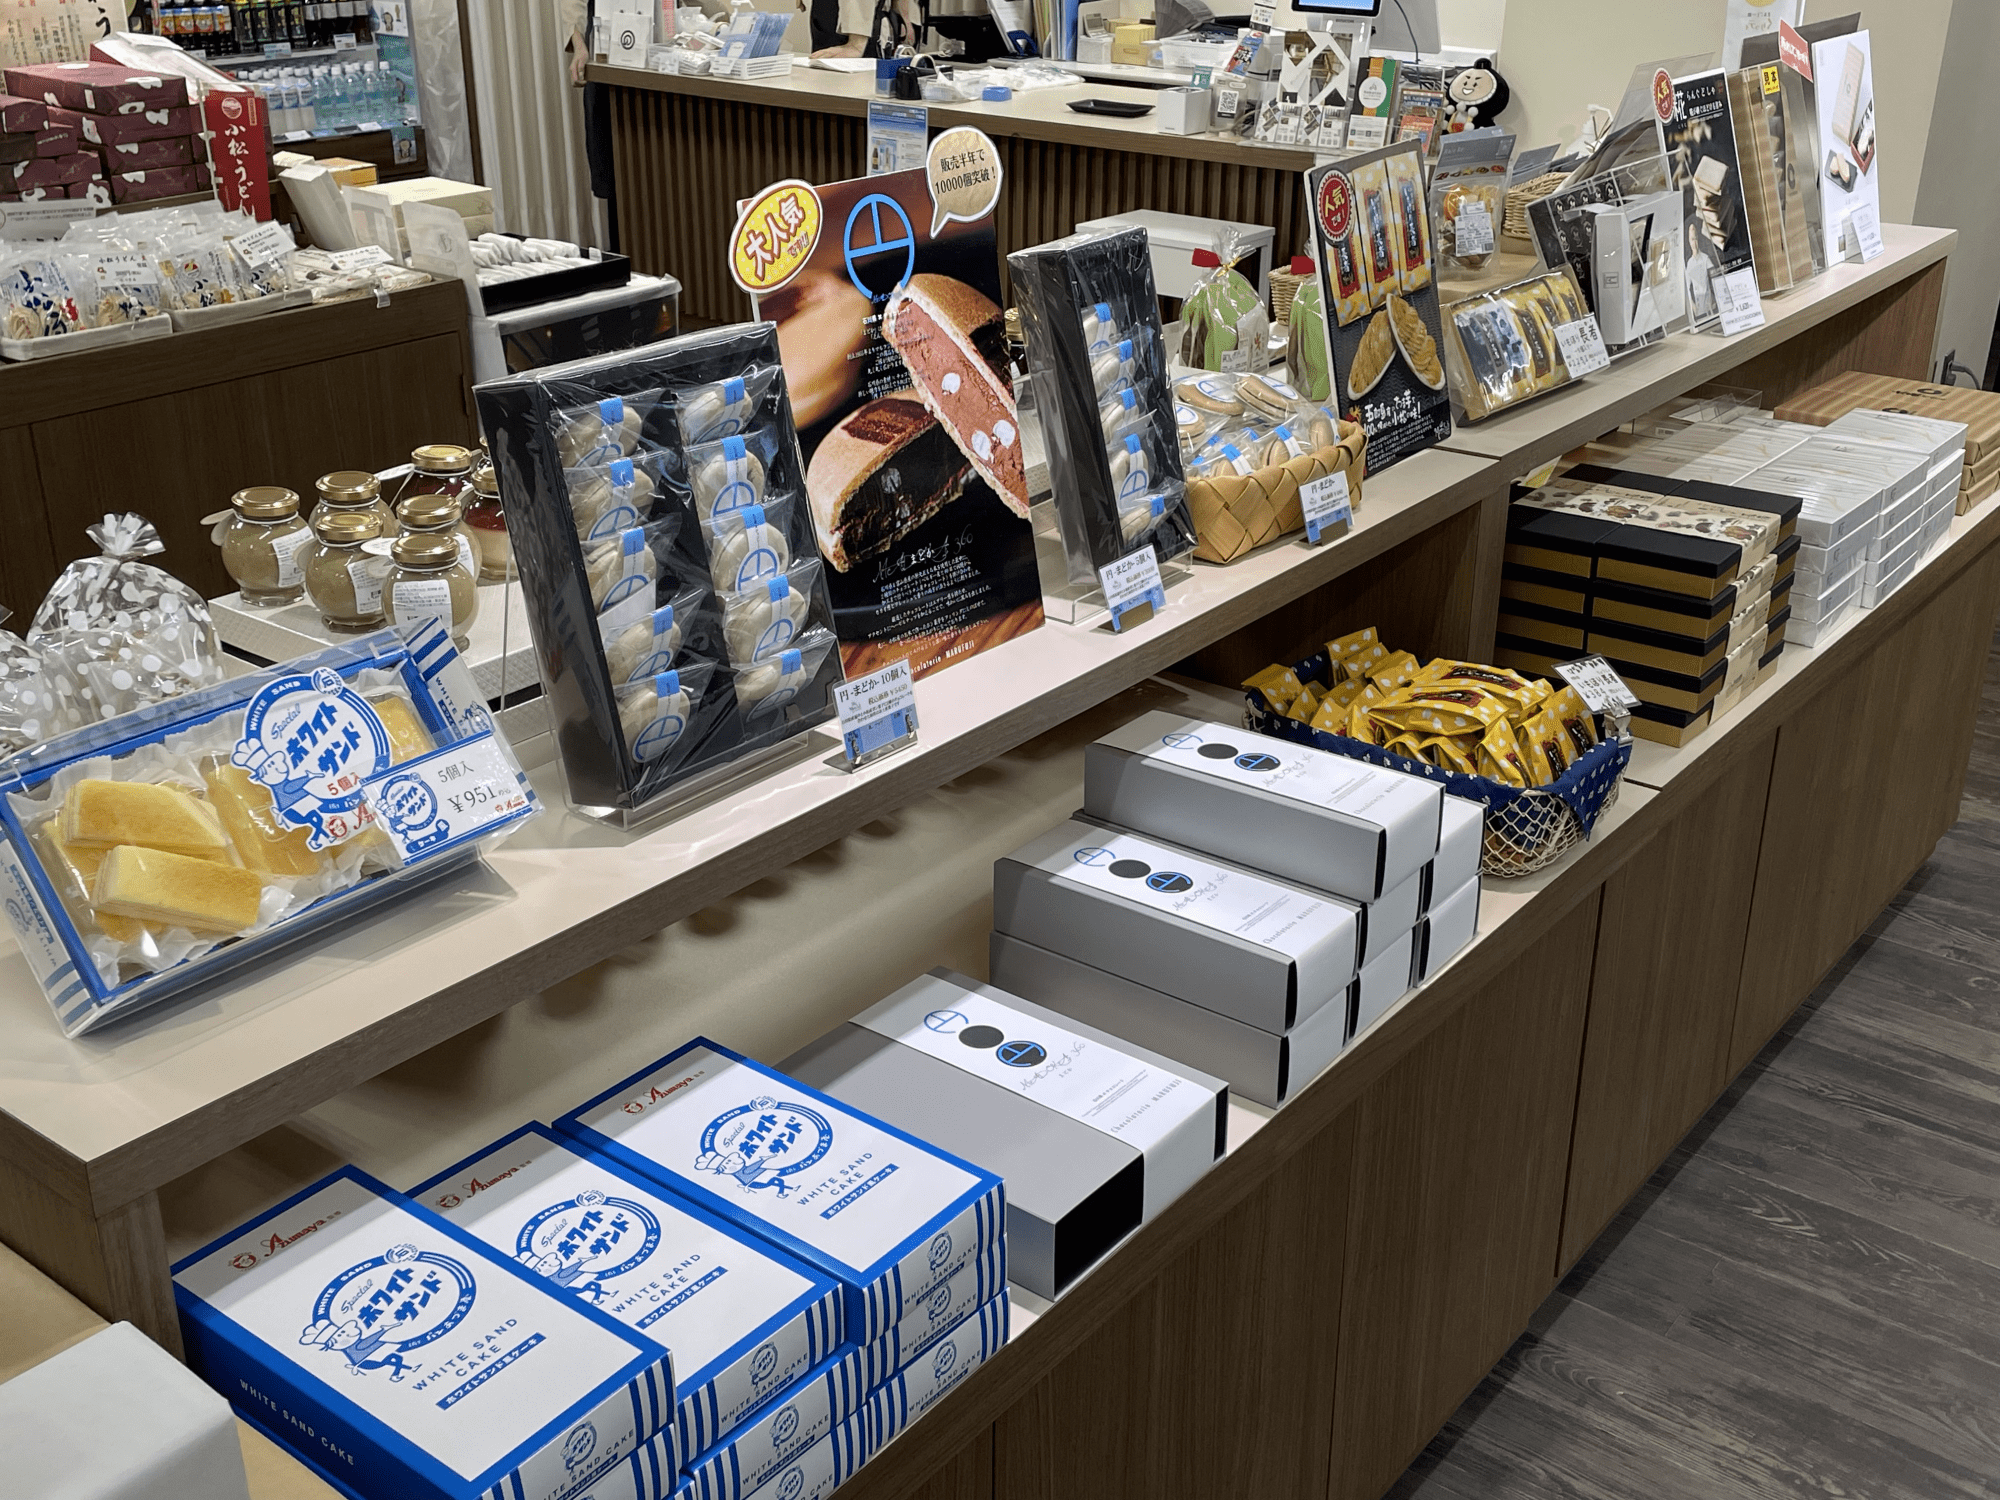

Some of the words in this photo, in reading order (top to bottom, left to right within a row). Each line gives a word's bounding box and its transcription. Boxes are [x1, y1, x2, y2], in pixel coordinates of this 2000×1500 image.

[1763, 71, 1777, 86] 見本
[940, 148, 985, 173] 販売半年で
[1325, 185, 1345, 218] 人気
[744, 192, 806, 282] 大人気
[946, 640, 975, 659] MARUFUJI
[250, 699, 268, 731] WHITE
[271, 681, 301, 696] SAND
[271, 702, 301, 740] Special
[286, 701, 338, 770] ホワイト
[317, 721, 361, 777] サンド
[438, 761, 474, 783] 5個入
[447, 785, 498, 813] ¥951
[647, 1076, 694, 1105] Azumaya
[704, 1127, 717, 1149] WHITE
[716, 1109, 742, 1125] SAND
[738, 1113, 779, 1160] ホワイト
[767, 1115, 803, 1155] サンド
[1110, 1103, 1151, 1133] Chocolaterie
[462, 1166, 519, 1199] Azumaya
[797, 1175, 839, 1207] WHITE
[841, 1152, 874, 1176] SAND
[830, 1170, 865, 1197] CAKE
[261, 1219, 326, 1258] Azumaya
[520, 1224, 535, 1249] WHITE
[538, 1204, 565, 1221] SAND
[541, 1218, 568, 1248] Special
[556, 1210, 604, 1261] ホワイト
[588, 1212, 630, 1258] サンド
[317, 1287, 337, 1316] WHITE
[340, 1262, 373, 1282] SAND
[611, 1282, 660, 1314] WHITE
[663, 1254, 702, 1281] SAND
[649, 1275, 690, 1303] CAKE
[904, 1282, 930, 1305] WHITE
[933, 1262, 953, 1282] SAND
[956, 1242, 977, 1263] CAKE
[341, 1278, 374, 1315] Special
[357, 1267, 415, 1331] ホワイト
[393, 1270, 443, 1323] サンド
[901, 1331, 927, 1354] WHITE
[931, 1311, 952, 1331] SAND
[956, 1293, 977, 1313] CAKE
[412, 1351, 469, 1392] WHITE
[472, 1318, 518, 1350] SAND
[455, 1344, 502, 1377] CAKE
[721, 1395, 751, 1424] WHITE
[755, 1374, 780, 1397] SAND
[784, 1352, 808, 1375] CAKE
[908, 1390, 934, 1412] WHITE
[937, 1369, 958, 1390] SAND
[961, 1350, 981, 1370] CAKE
[240, 1379, 277, 1412] WHITE
[283, 1410, 315, 1437] SAND
[321, 1437, 354, 1466] CAKE
[572, 1456, 601, 1483] SAND
[606, 1428, 634, 1455] CAKE
[742, 1458, 773, 1485] WHITE
[776, 1436, 802, 1458] SAND
[805, 1413, 829, 1436] CAKE
[810, 1473, 833, 1495] CAKE
